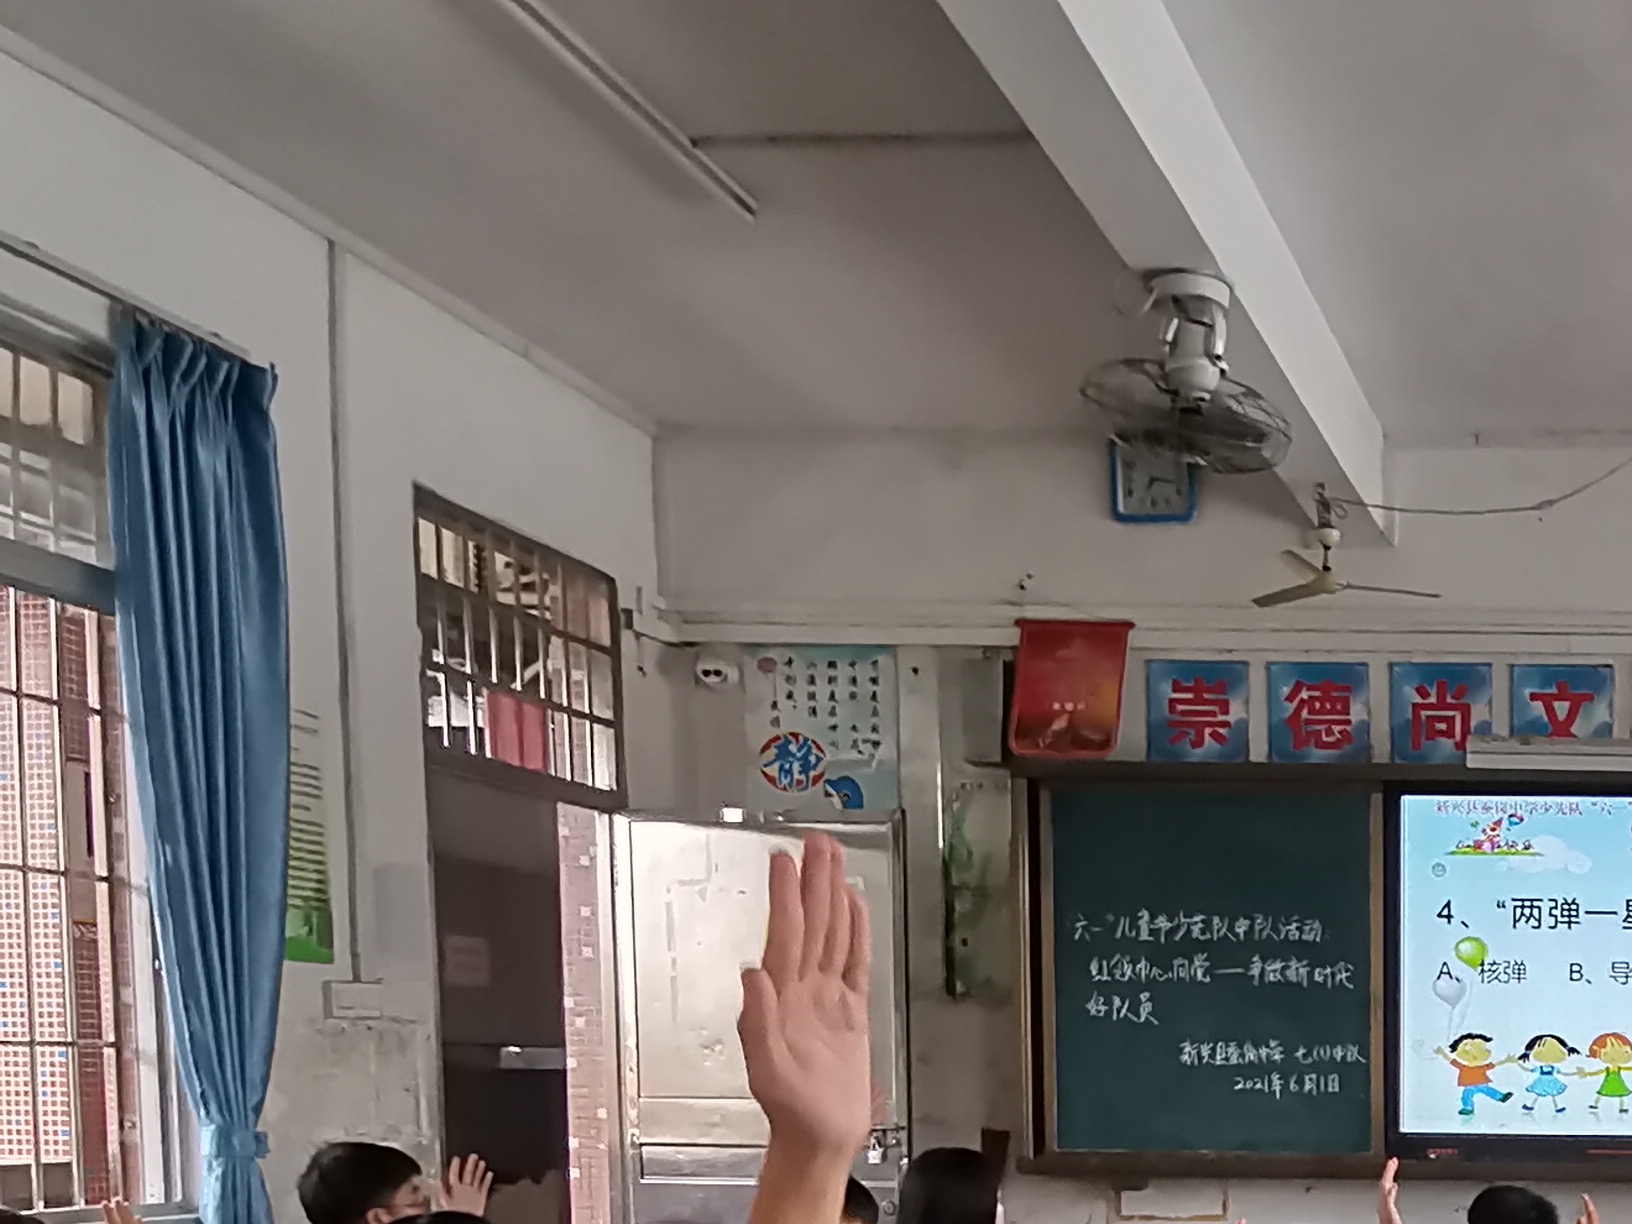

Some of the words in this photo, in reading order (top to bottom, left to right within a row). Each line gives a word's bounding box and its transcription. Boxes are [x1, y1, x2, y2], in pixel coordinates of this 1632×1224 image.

[1167, 677, 1595, 751] 崇德尚文
[1436, 960, 1527, 985] A、核弹
[1085, 990, 1159, 1025] 好队员
